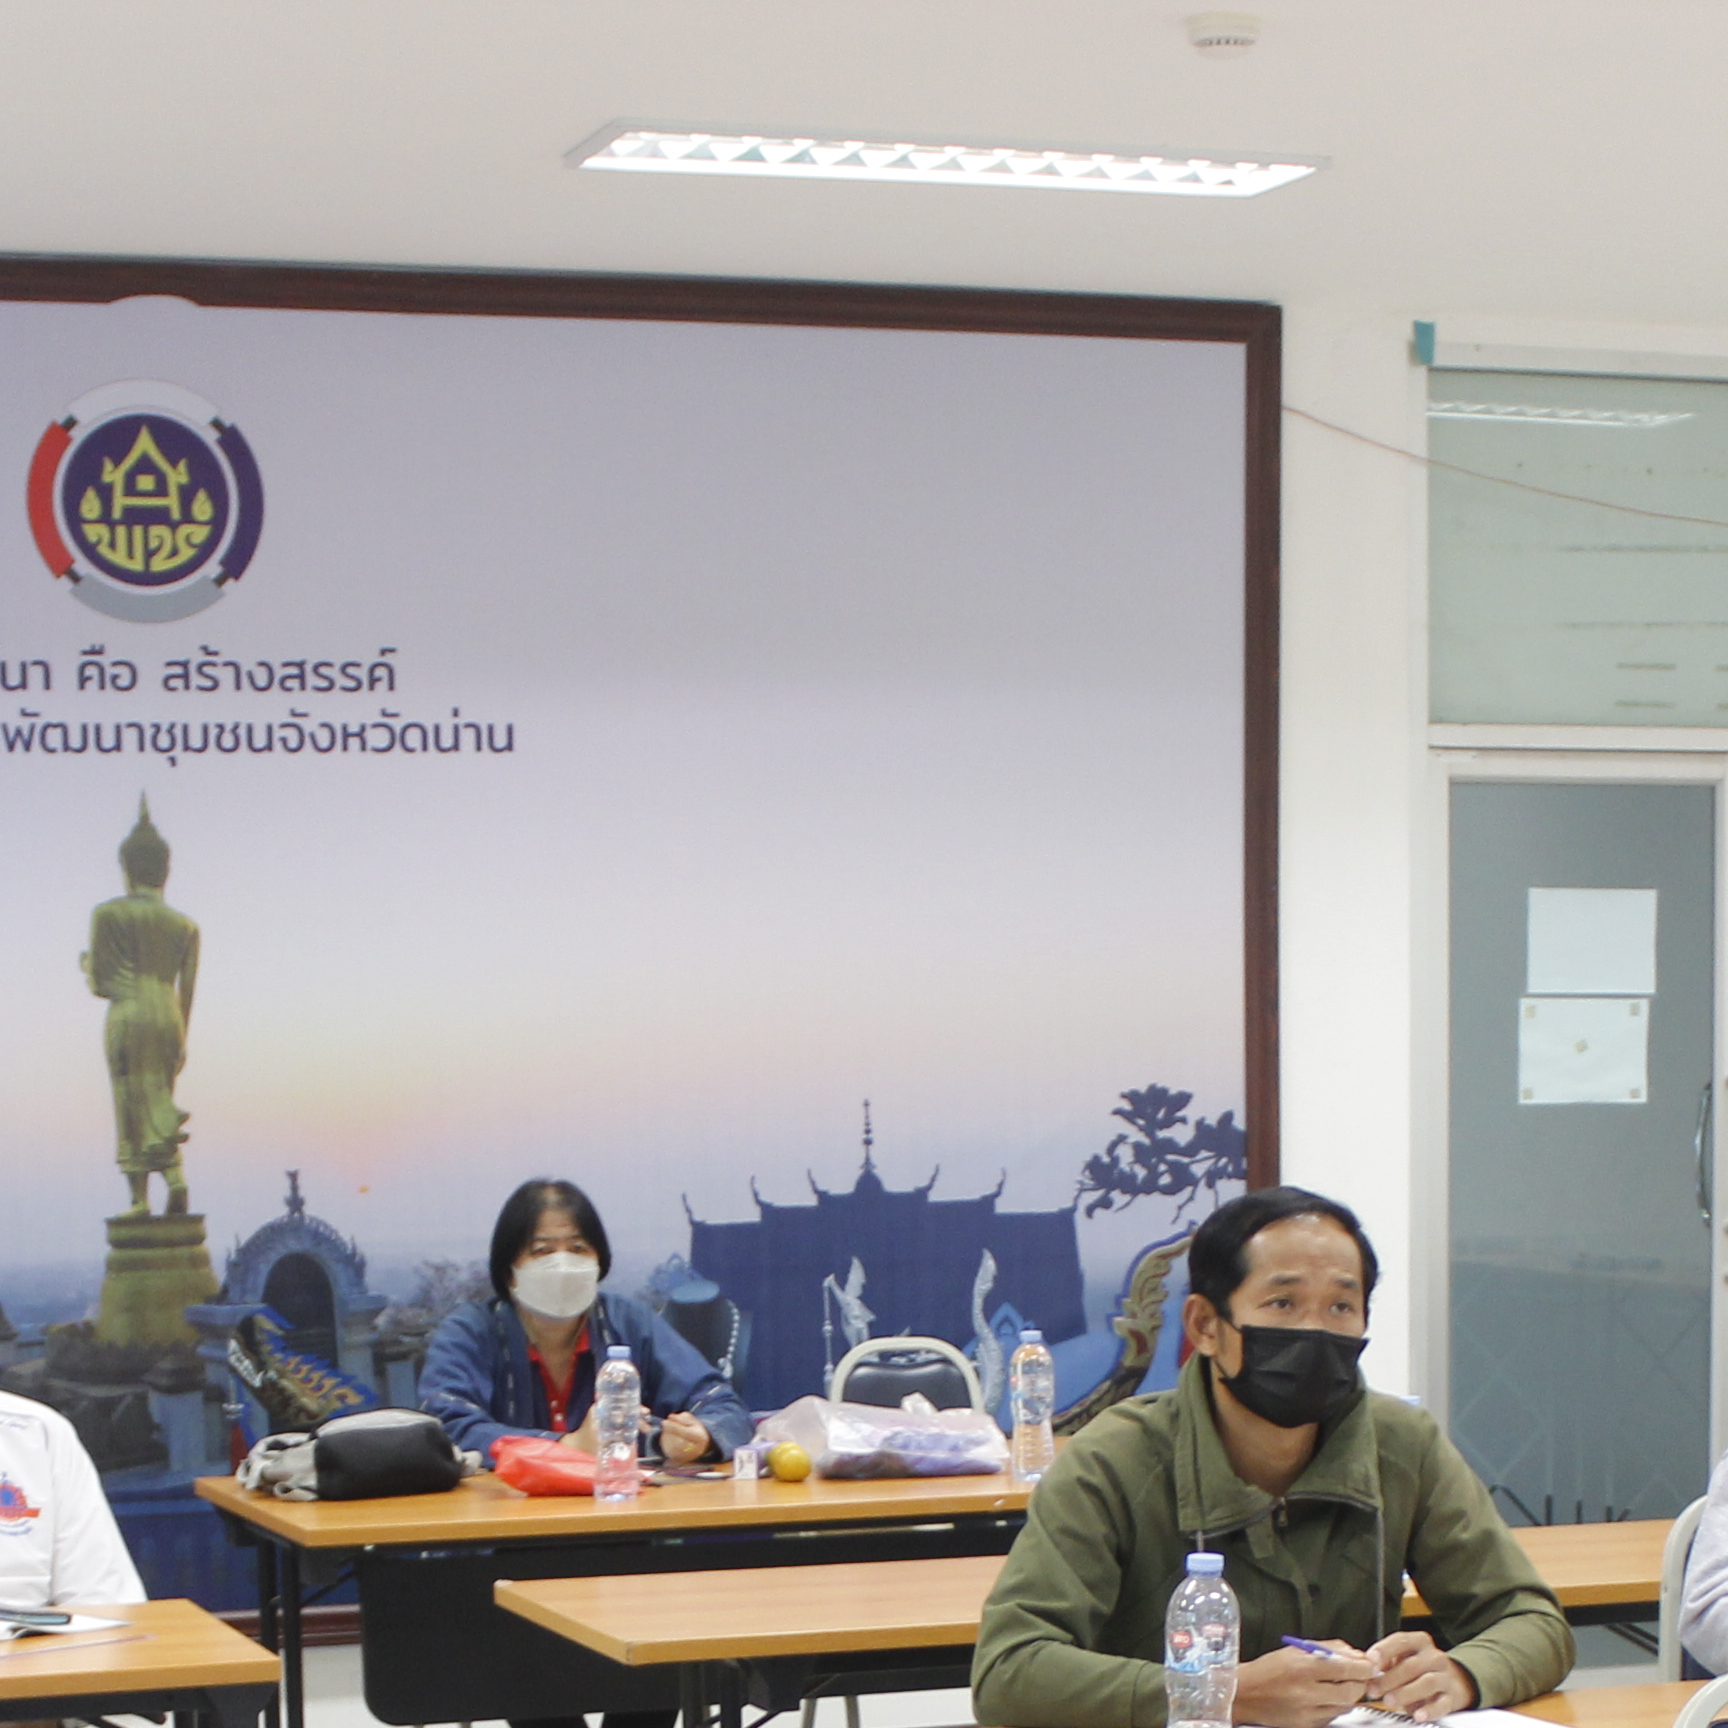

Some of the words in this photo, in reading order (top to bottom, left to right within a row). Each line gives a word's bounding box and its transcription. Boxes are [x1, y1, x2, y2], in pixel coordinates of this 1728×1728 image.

[77, 642, 139, 694] คือ
[161, 645, 398, 694] สร้างสรรค์
